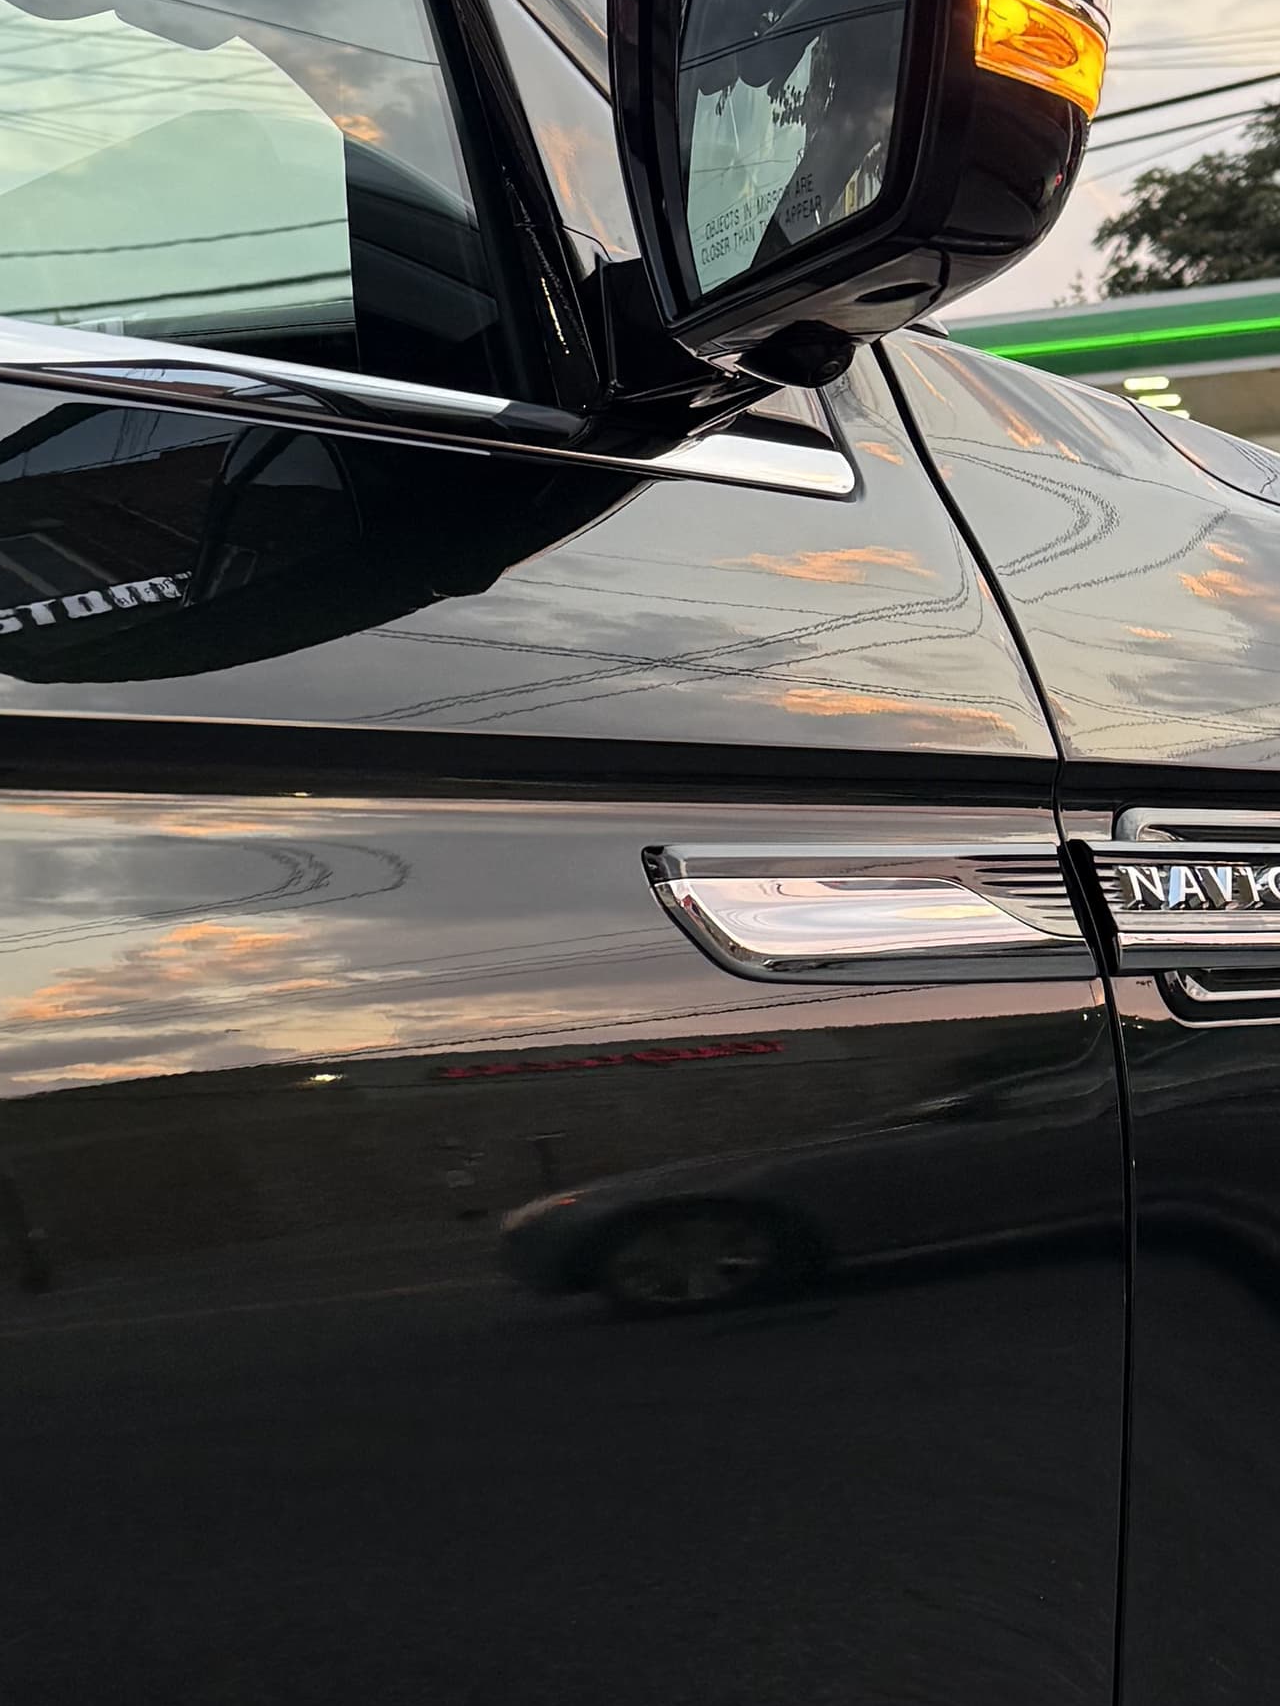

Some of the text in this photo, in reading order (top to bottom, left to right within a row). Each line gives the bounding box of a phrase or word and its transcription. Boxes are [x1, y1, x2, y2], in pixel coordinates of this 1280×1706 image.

[701, 236, 731, 266] CLOSER
[733, 225, 756, 252] THAN
[785, 194, 823, 224] APPEAR
[704, 208, 740, 241] OBJECTS
[743, 201, 753, 221] IN
[795, 173, 814, 197] ARE
